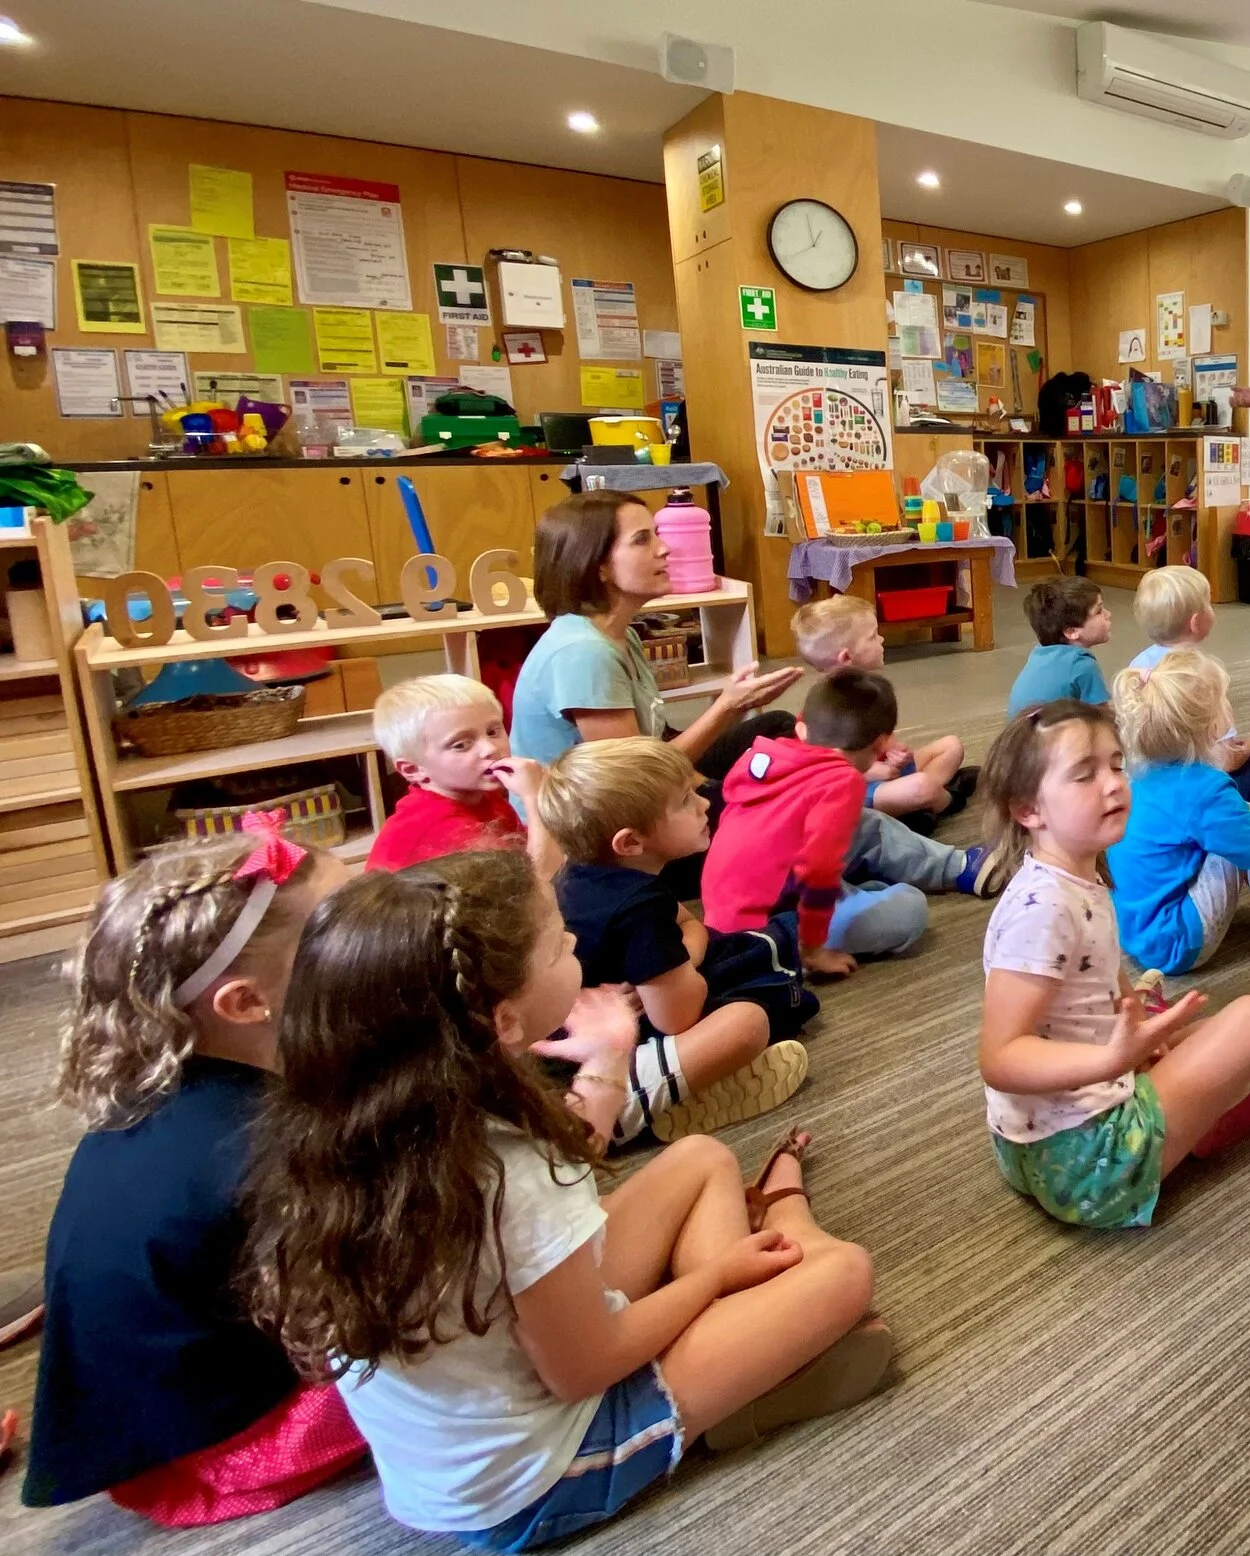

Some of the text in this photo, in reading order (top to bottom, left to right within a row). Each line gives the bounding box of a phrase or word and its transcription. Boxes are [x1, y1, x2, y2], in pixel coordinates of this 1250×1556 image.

[442, 312, 489, 321] FIRST AID
[756, 364, 868, 381] Australian Guide to Healthy Eating
